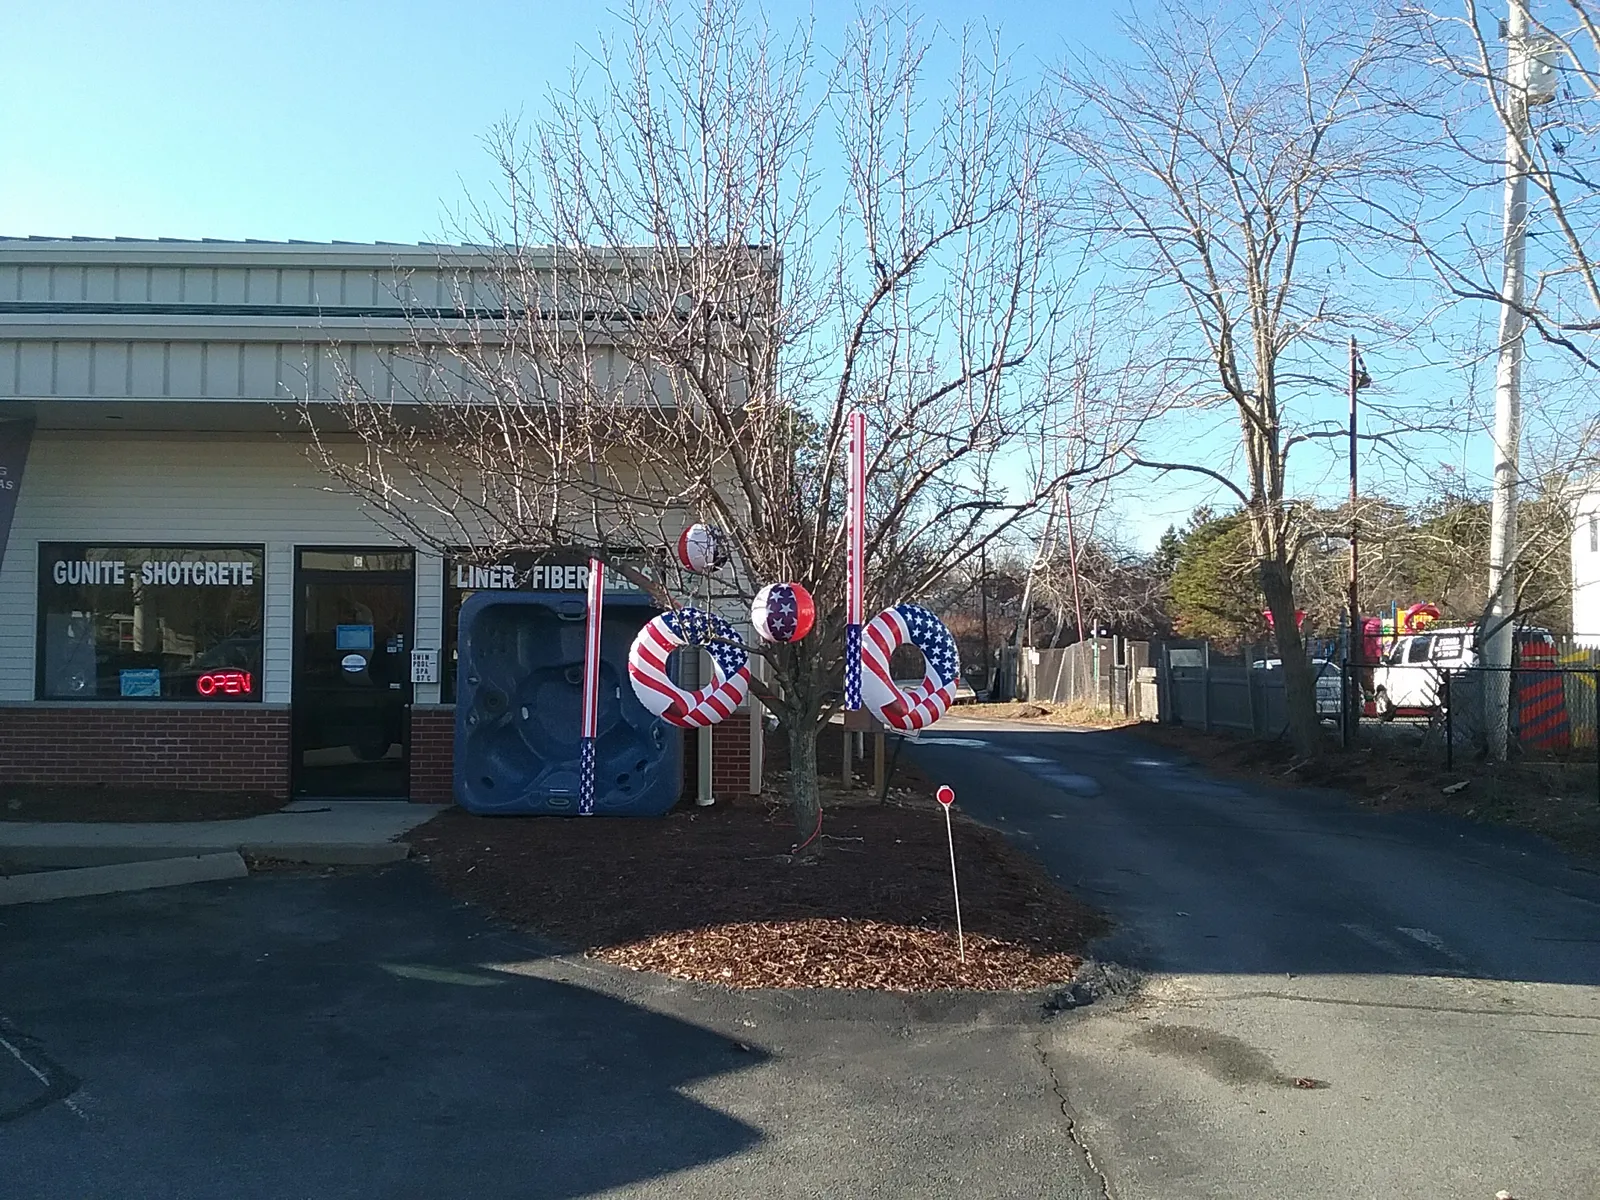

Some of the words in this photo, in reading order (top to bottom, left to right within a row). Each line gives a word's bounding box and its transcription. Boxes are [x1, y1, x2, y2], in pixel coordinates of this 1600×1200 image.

[53, 560, 125, 585] GUNITE
[141, 561, 254, 586] SHOTCRETE
[457, 564, 515, 589] LINER
[532, 564, 654, 590] FIBERLAS
[199, 673, 251, 694] OPEN
